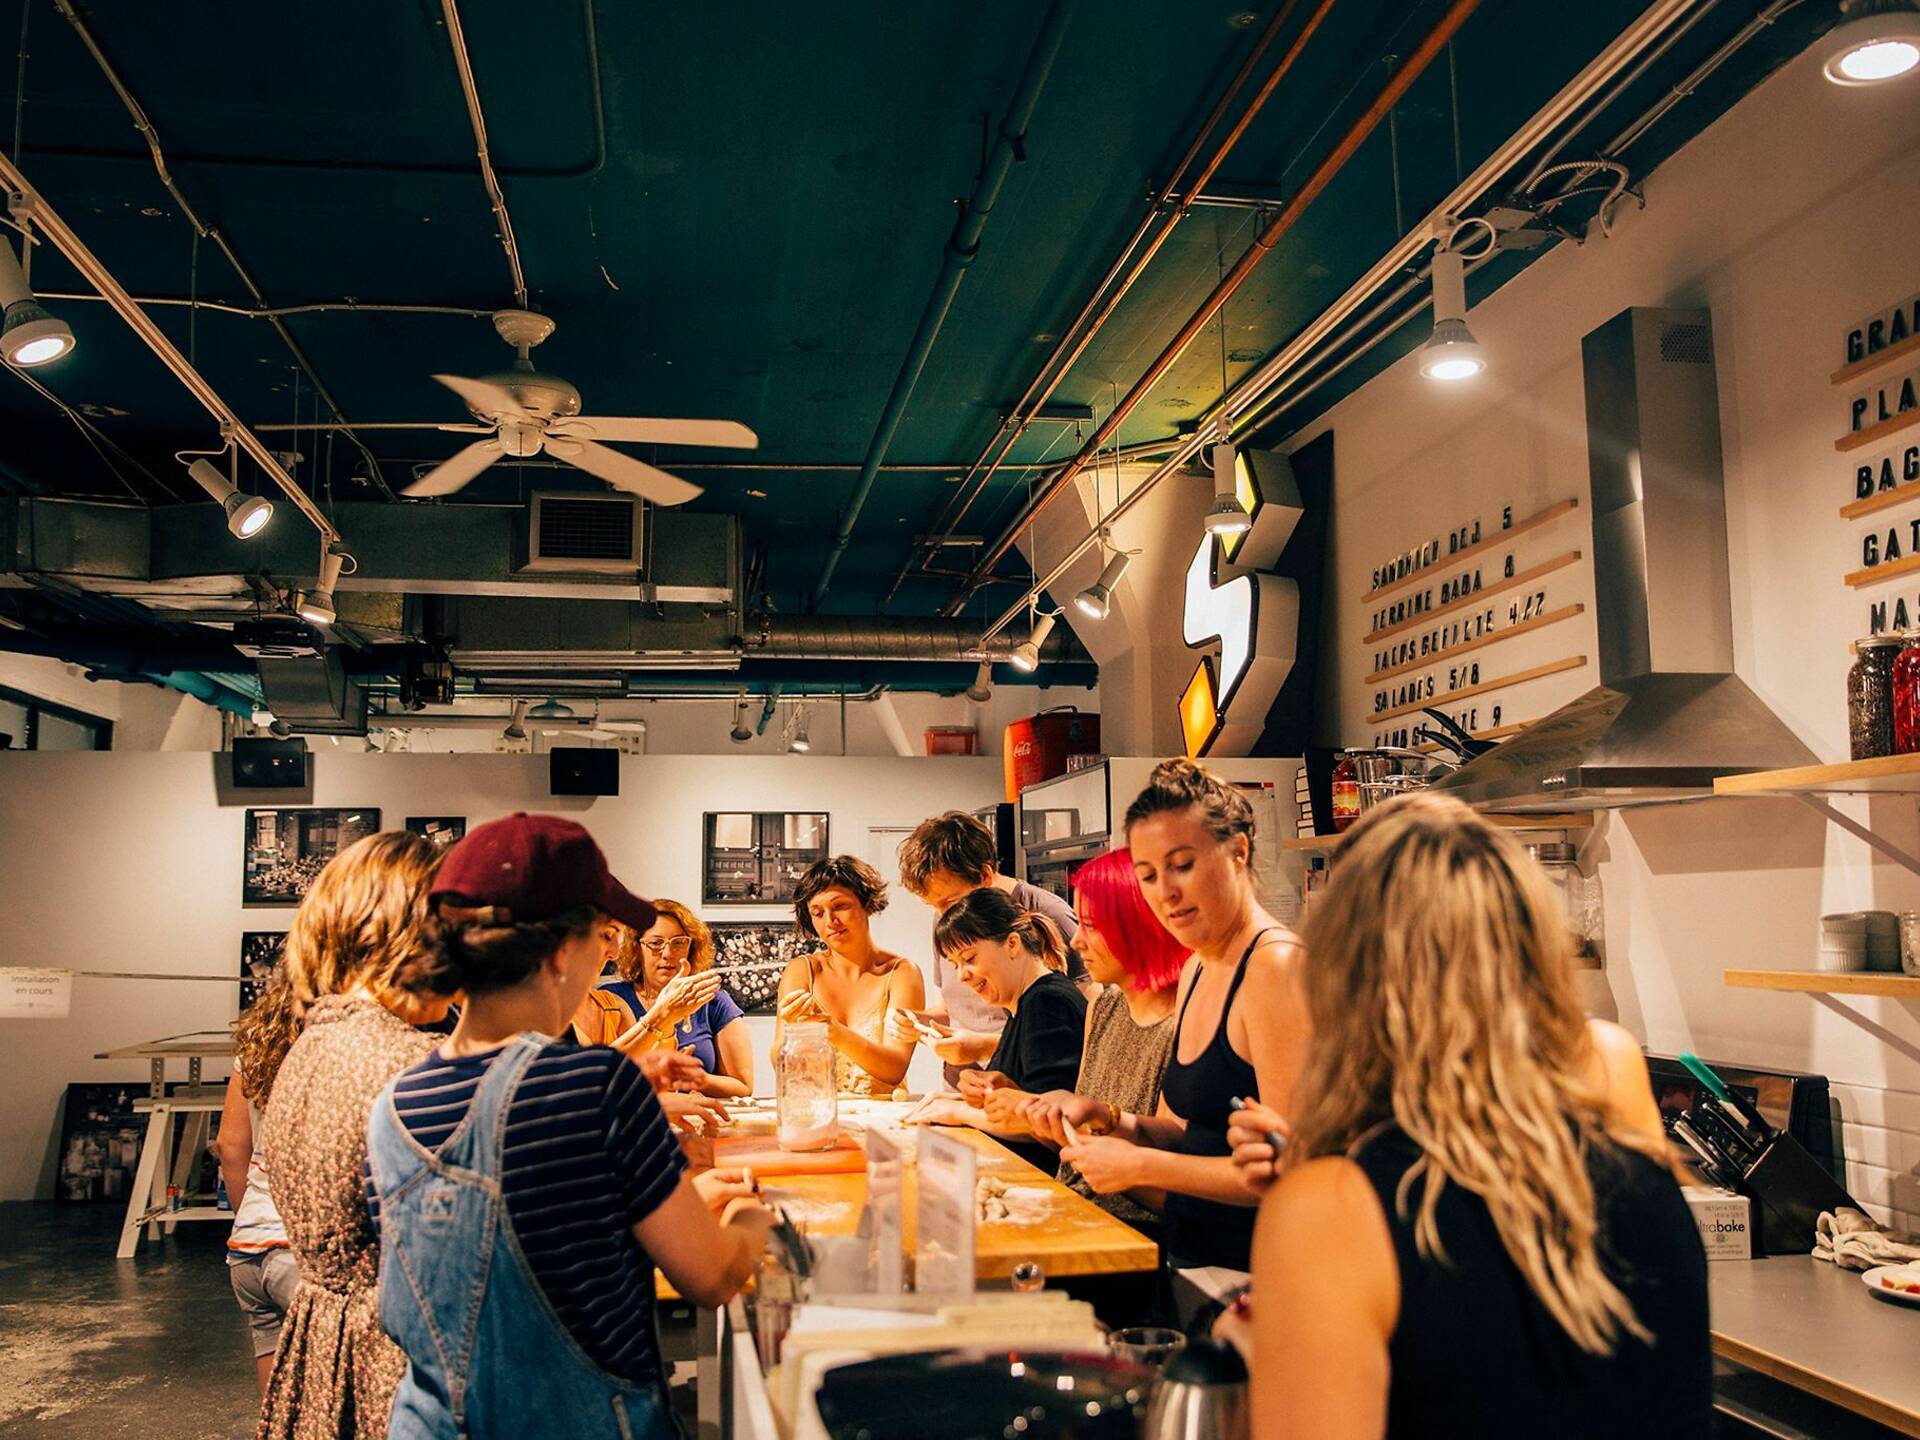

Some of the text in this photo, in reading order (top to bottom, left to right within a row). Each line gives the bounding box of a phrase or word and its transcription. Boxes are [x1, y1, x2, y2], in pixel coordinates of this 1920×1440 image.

[1856, 446, 1920, 499] BAG
[1450, 521, 1480, 554] DEJ
[1503, 506, 1512, 530] 5
[1372, 554, 1514, 633] TERRINE BABA 8
[1870, 594, 1920, 635] MA
[1374, 640, 1416, 673] TACOS
[1421, 609, 1493, 656] GEFILTE
[1375, 663, 1479, 712] SALADES 5/8
